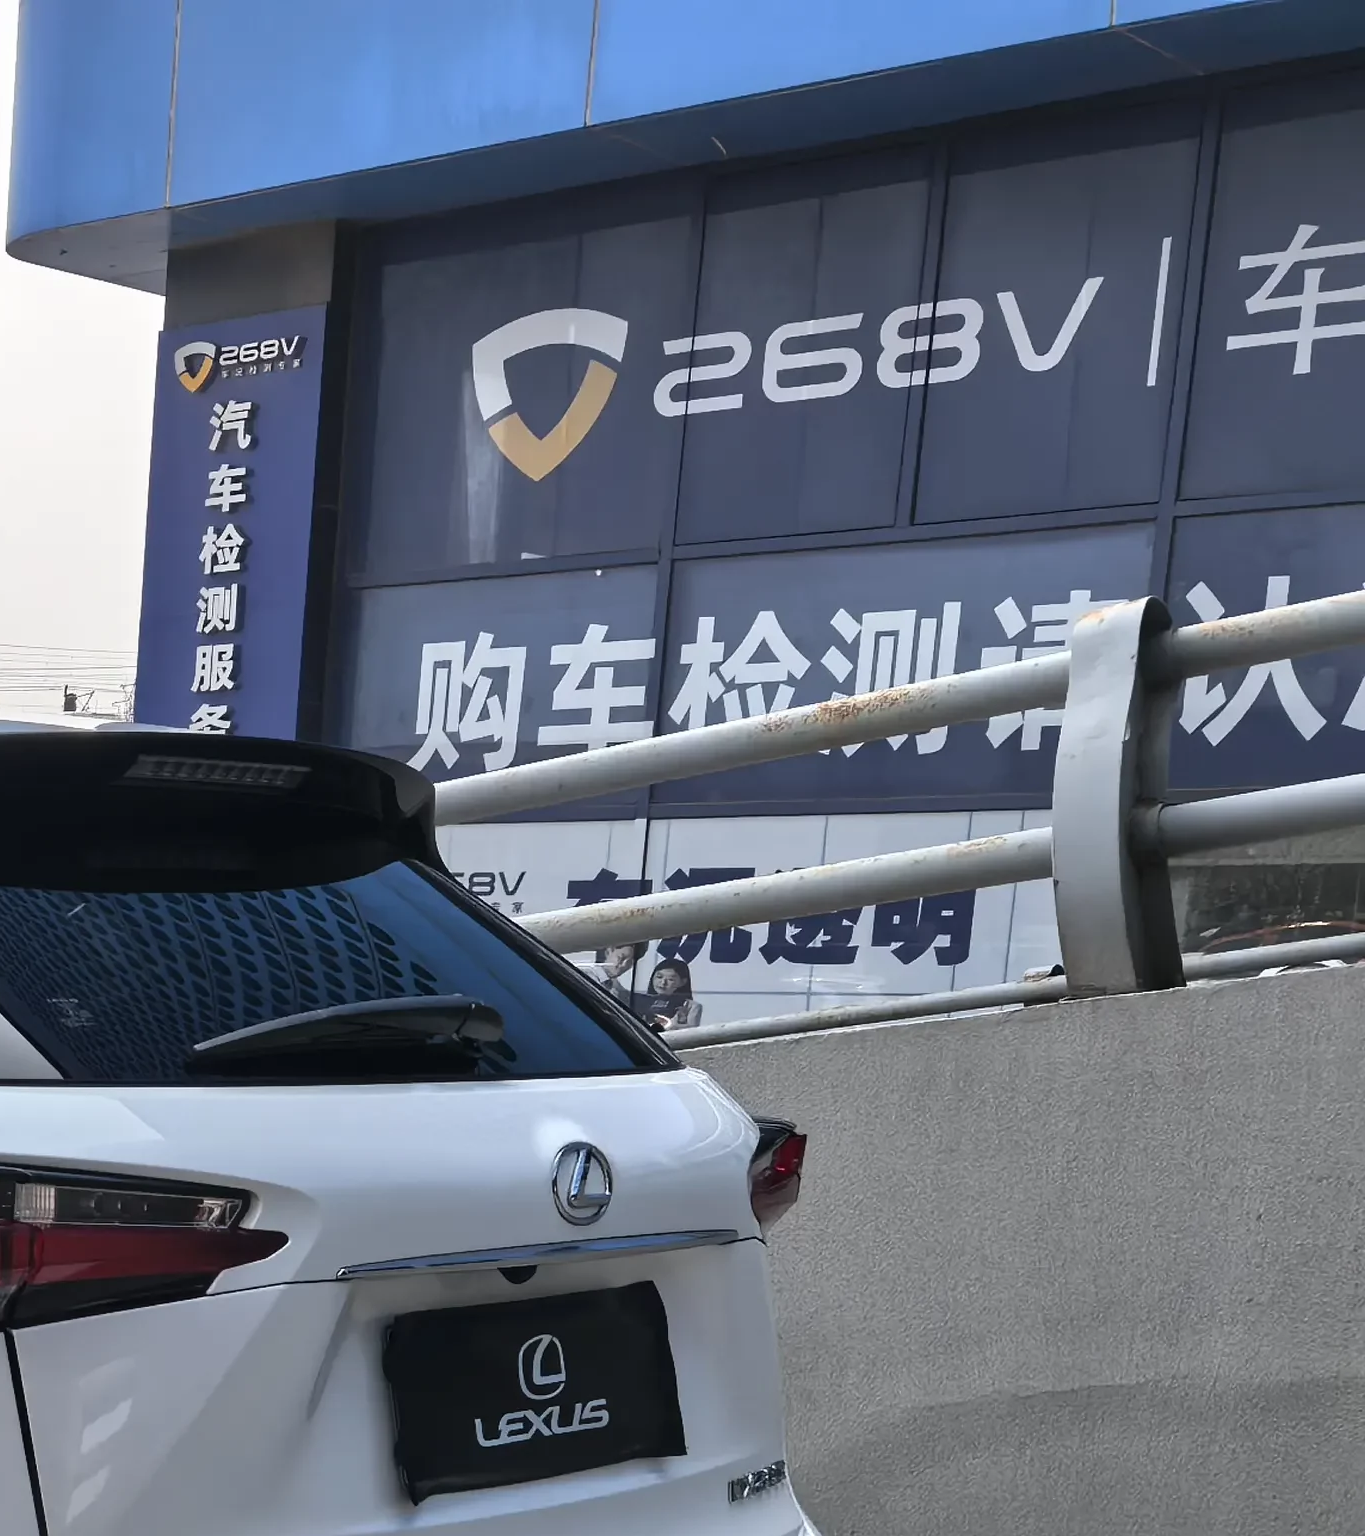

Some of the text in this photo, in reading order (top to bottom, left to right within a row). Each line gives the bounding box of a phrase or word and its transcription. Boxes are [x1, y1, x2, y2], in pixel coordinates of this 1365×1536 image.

[653, 224, 1365, 417] 268V 车
[219, 335, 300, 366] 268V
[453, 871, 527, 896] 8V
[474, 1398, 610, 1448] LEXUS
